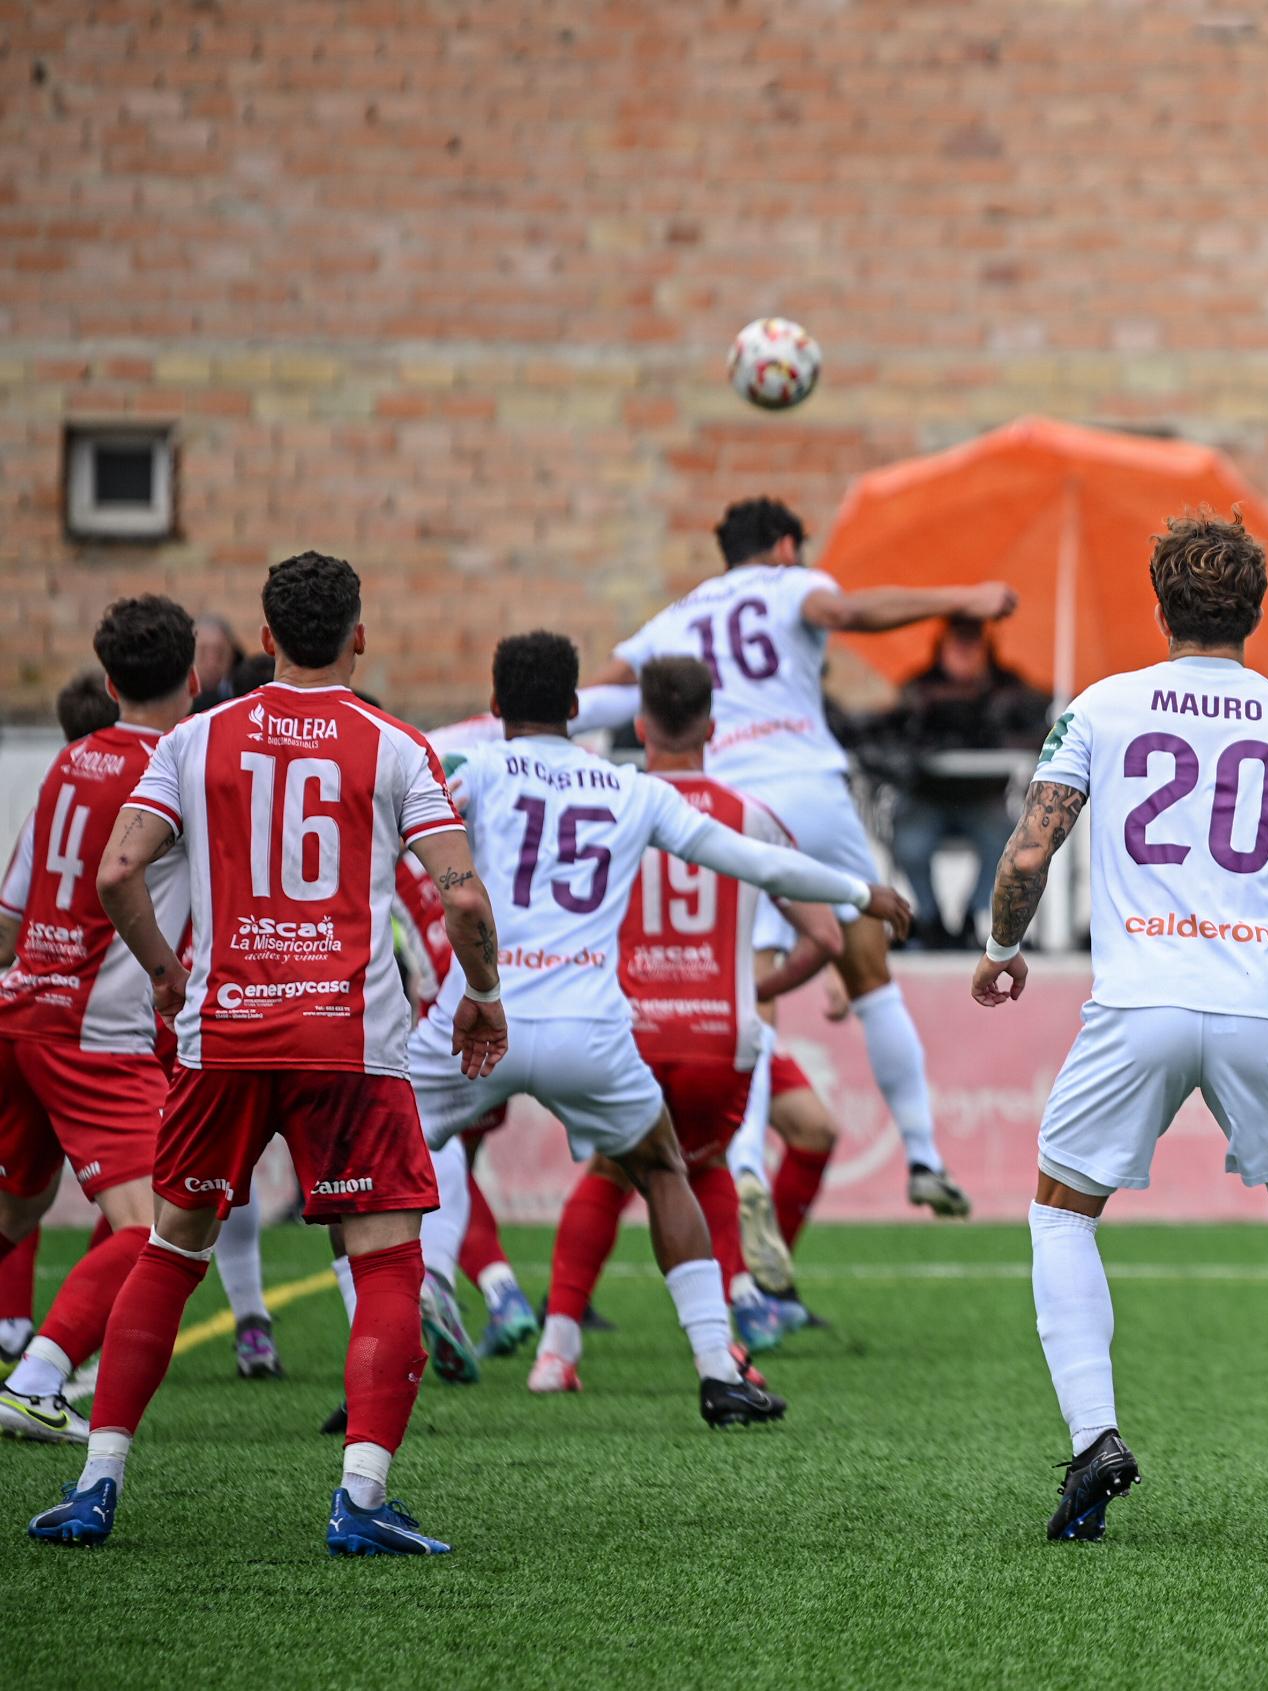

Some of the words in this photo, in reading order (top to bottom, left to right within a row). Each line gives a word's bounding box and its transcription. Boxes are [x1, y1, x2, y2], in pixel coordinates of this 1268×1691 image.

[687, 597, 779, 690] 16
[268, 714, 338, 740] MOLERA
[1150, 690, 1263, 721] MAURO
[46, 783, 91, 910] 4
[240, 751, 341, 901] 16
[510, 797, 617, 914] 15
[641, 844, 717, 936] 19
[230, 934, 250, 951] La
[253, 934, 342, 952] Misericordia
[244, 980, 350, 998] energycasa
